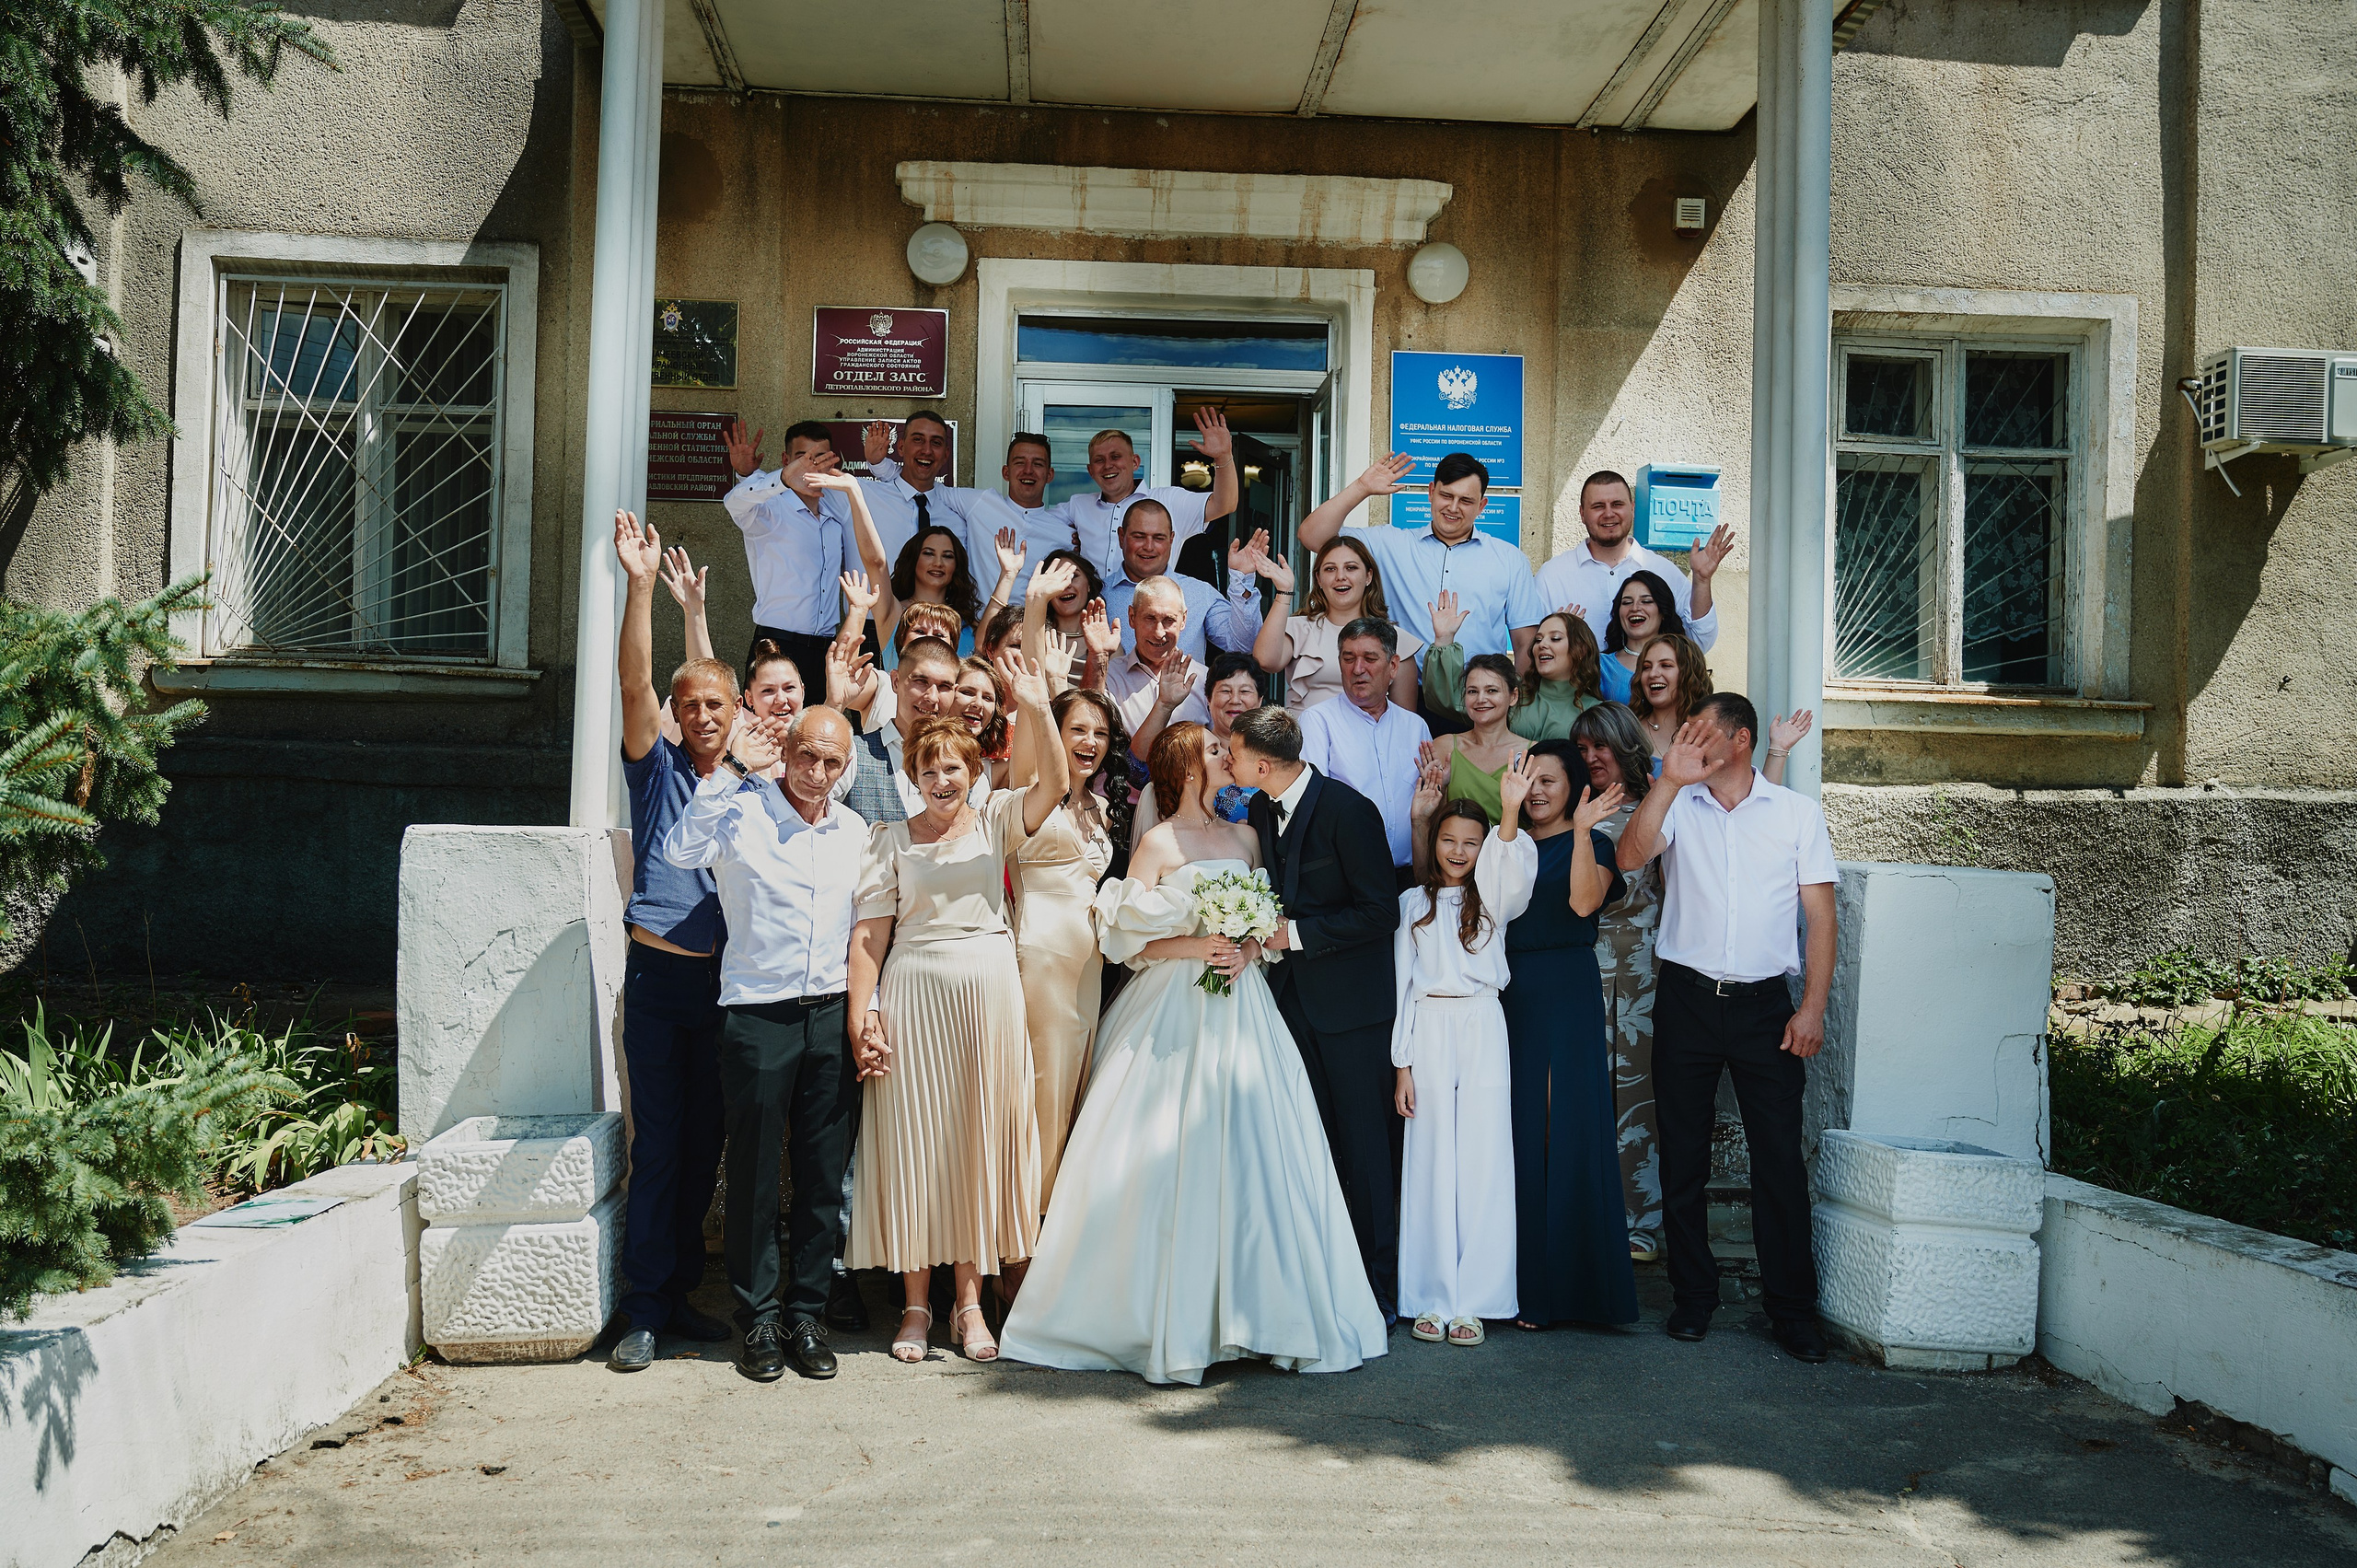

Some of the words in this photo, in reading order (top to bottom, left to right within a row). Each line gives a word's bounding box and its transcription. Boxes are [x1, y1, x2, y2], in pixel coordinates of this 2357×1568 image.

[691, 372, 720, 382] ОТДЕЛ
[833, 370, 885, 383] ОТДЕЛ
[888, 372, 926, 382] ЗАГС
[825, 383, 901, 391] ПЕТРОПАВЛОВСКОГО
[697, 422, 722, 430] ОРГАН
[1399, 423, 1446, 431] ФЕДЕРАЛЬНАЯ
[1447, 424, 1484, 433] НАЛОГОВАЯ
[681, 433, 716, 441] СЛУЖБЫ
[688, 456, 723, 464] ОБЛАСТИ
[678, 474, 727, 482] ПРЕДПРИЯТИЙ
[691, 484, 716, 493] РАЙОН)
[1654, 498, 1713, 517] ПОЧТА
